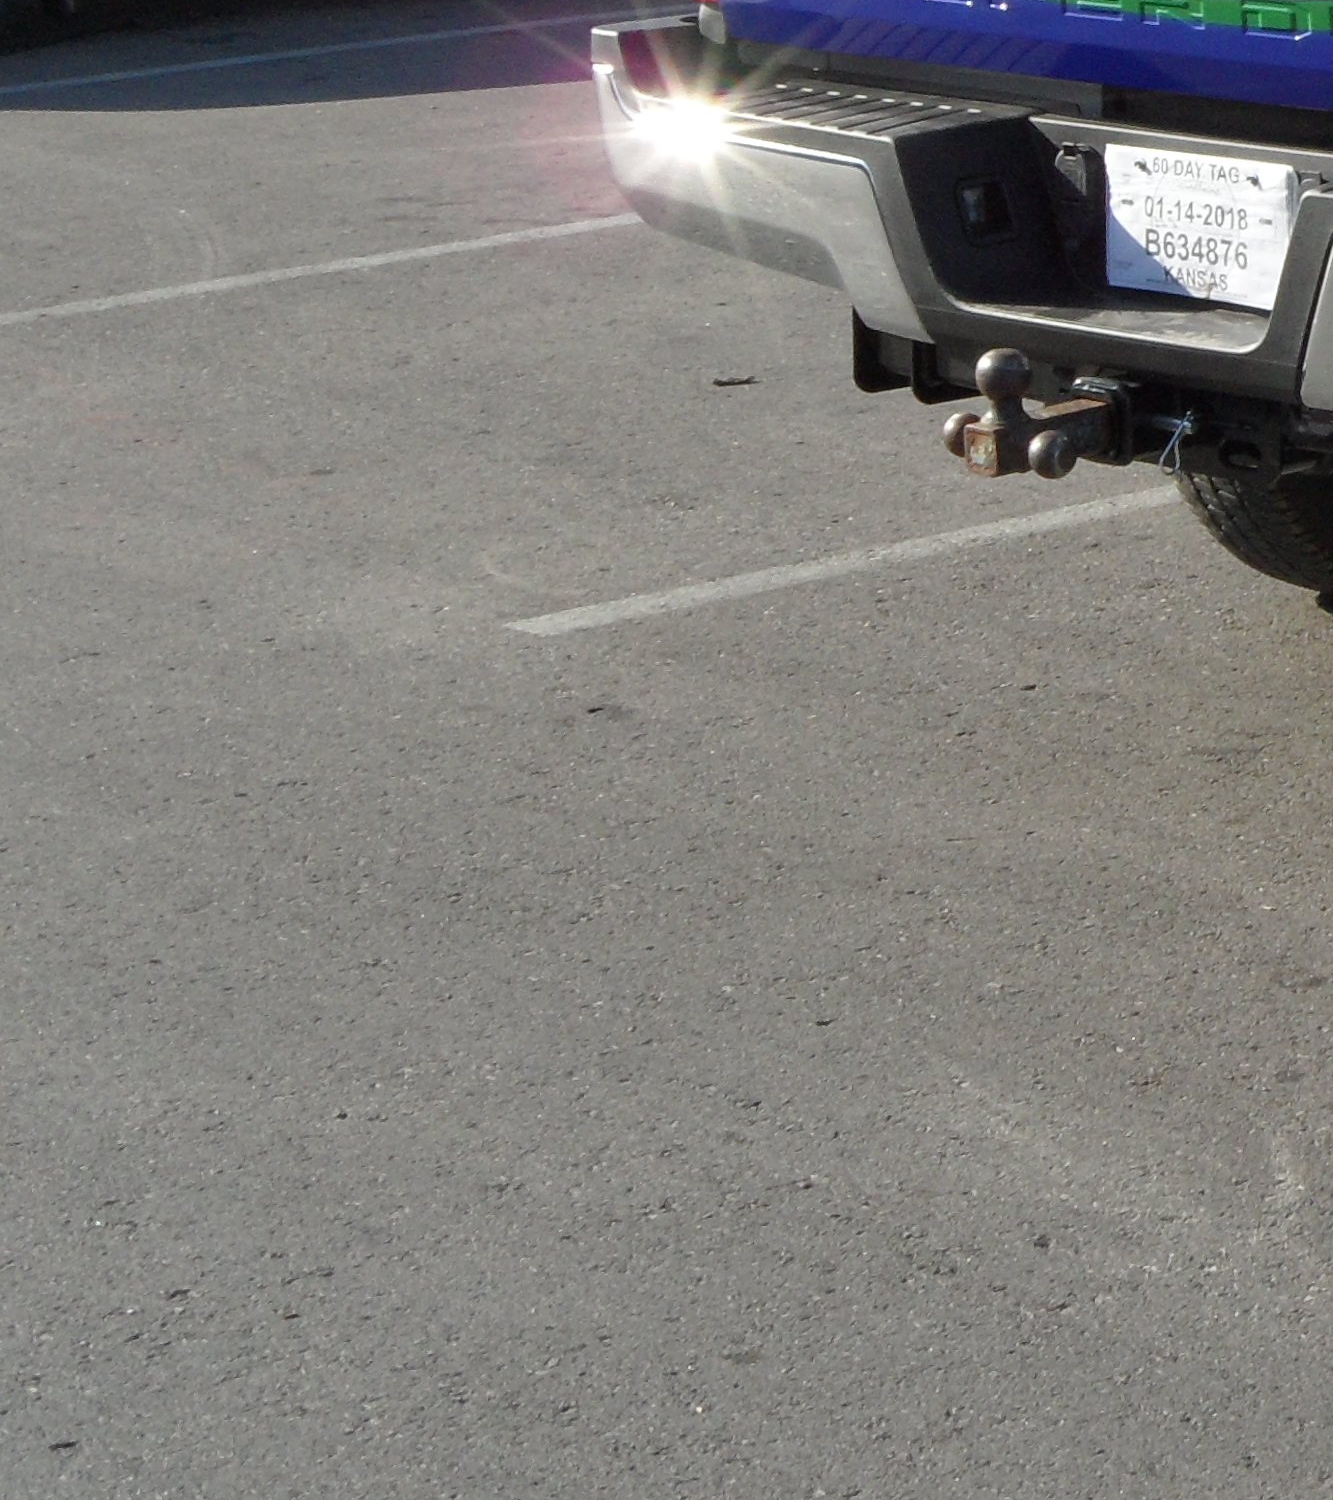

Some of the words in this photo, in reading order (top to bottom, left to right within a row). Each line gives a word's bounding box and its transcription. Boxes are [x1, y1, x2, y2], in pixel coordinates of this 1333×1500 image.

[1152, 157, 1169, 175] 60
[1174, 159, 1204, 180] DAY
[1209, 164, 1240, 184] TAG
[1144, 195, 1248, 231] 01-14-2018
[1145, 228, 1248, 270] B634876
[1163, 265, 1229, 292] KANSAS
